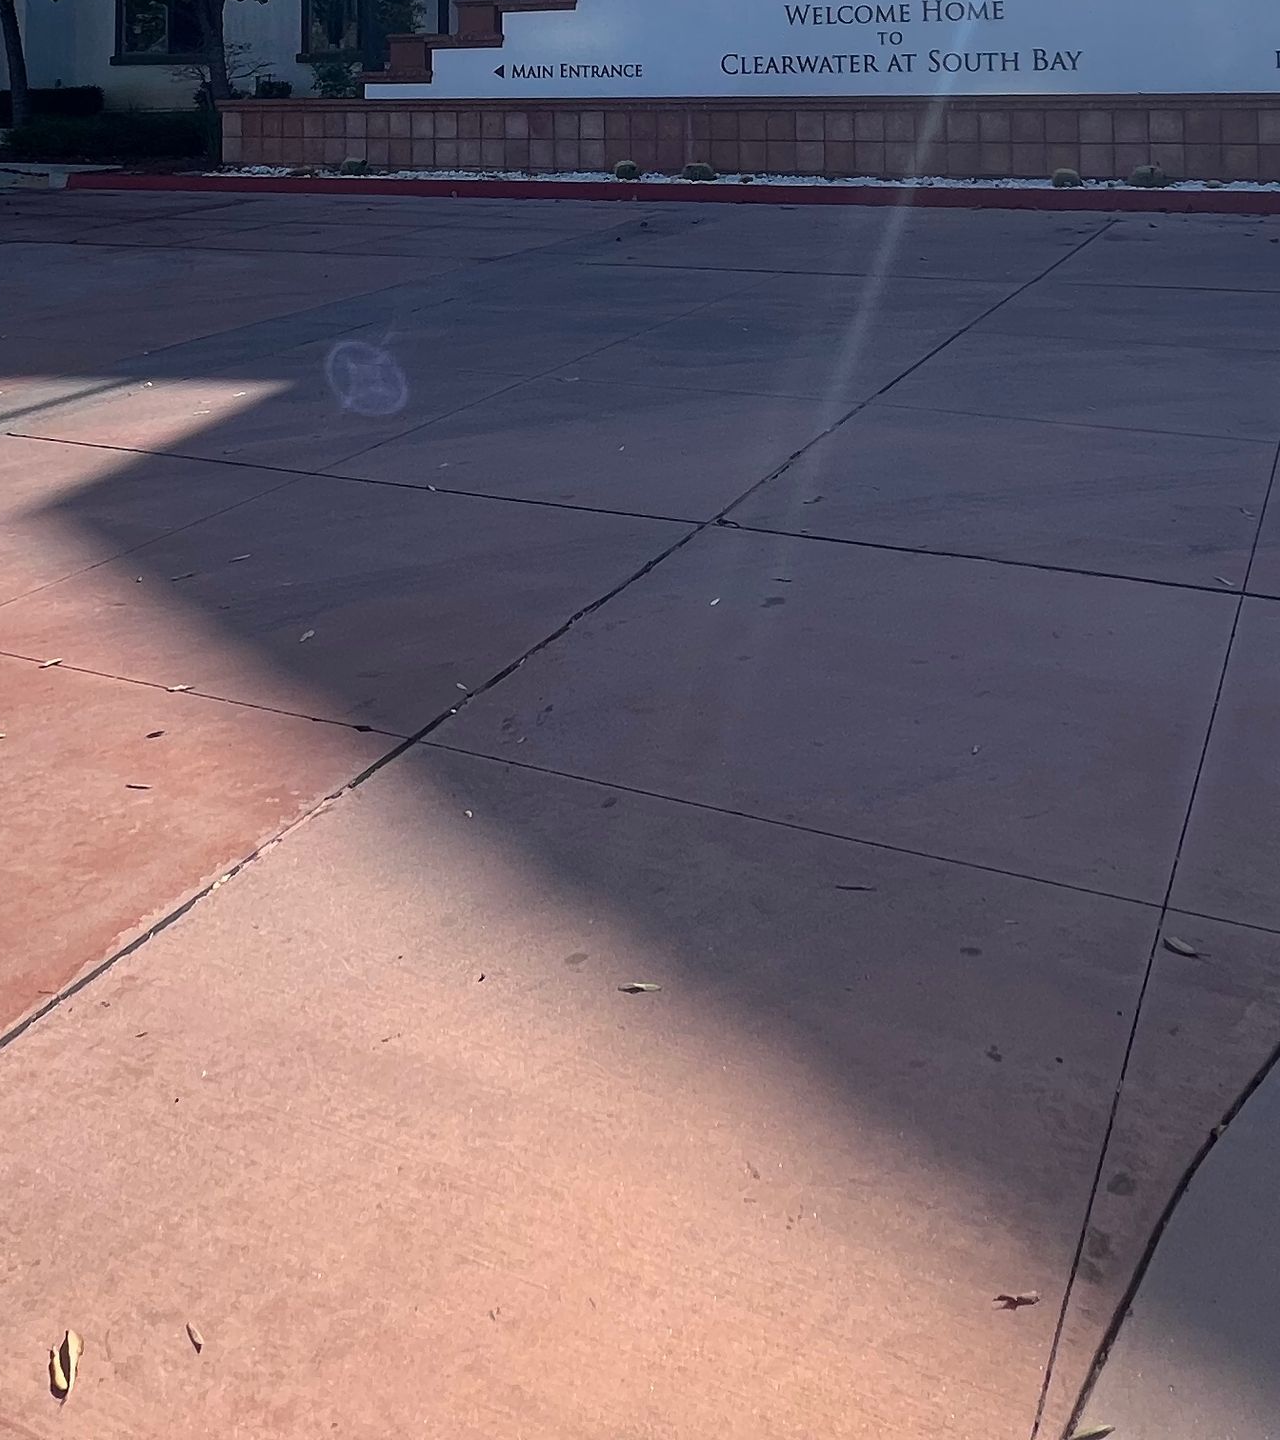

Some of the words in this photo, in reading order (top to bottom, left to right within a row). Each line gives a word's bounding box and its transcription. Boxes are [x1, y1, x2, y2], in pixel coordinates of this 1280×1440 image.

[783, 3, 912, 26] WELCOME
[921, 0, 1005, 22] HOME
[511, 63, 554, 79] MAIN
[559, 63, 643, 79] ENTRANCE
[721, 53, 880, 75] CLEARWATER
[928, 49, 1020, 73] SOUTH
[1032, 48, 1084, 71] BAY
